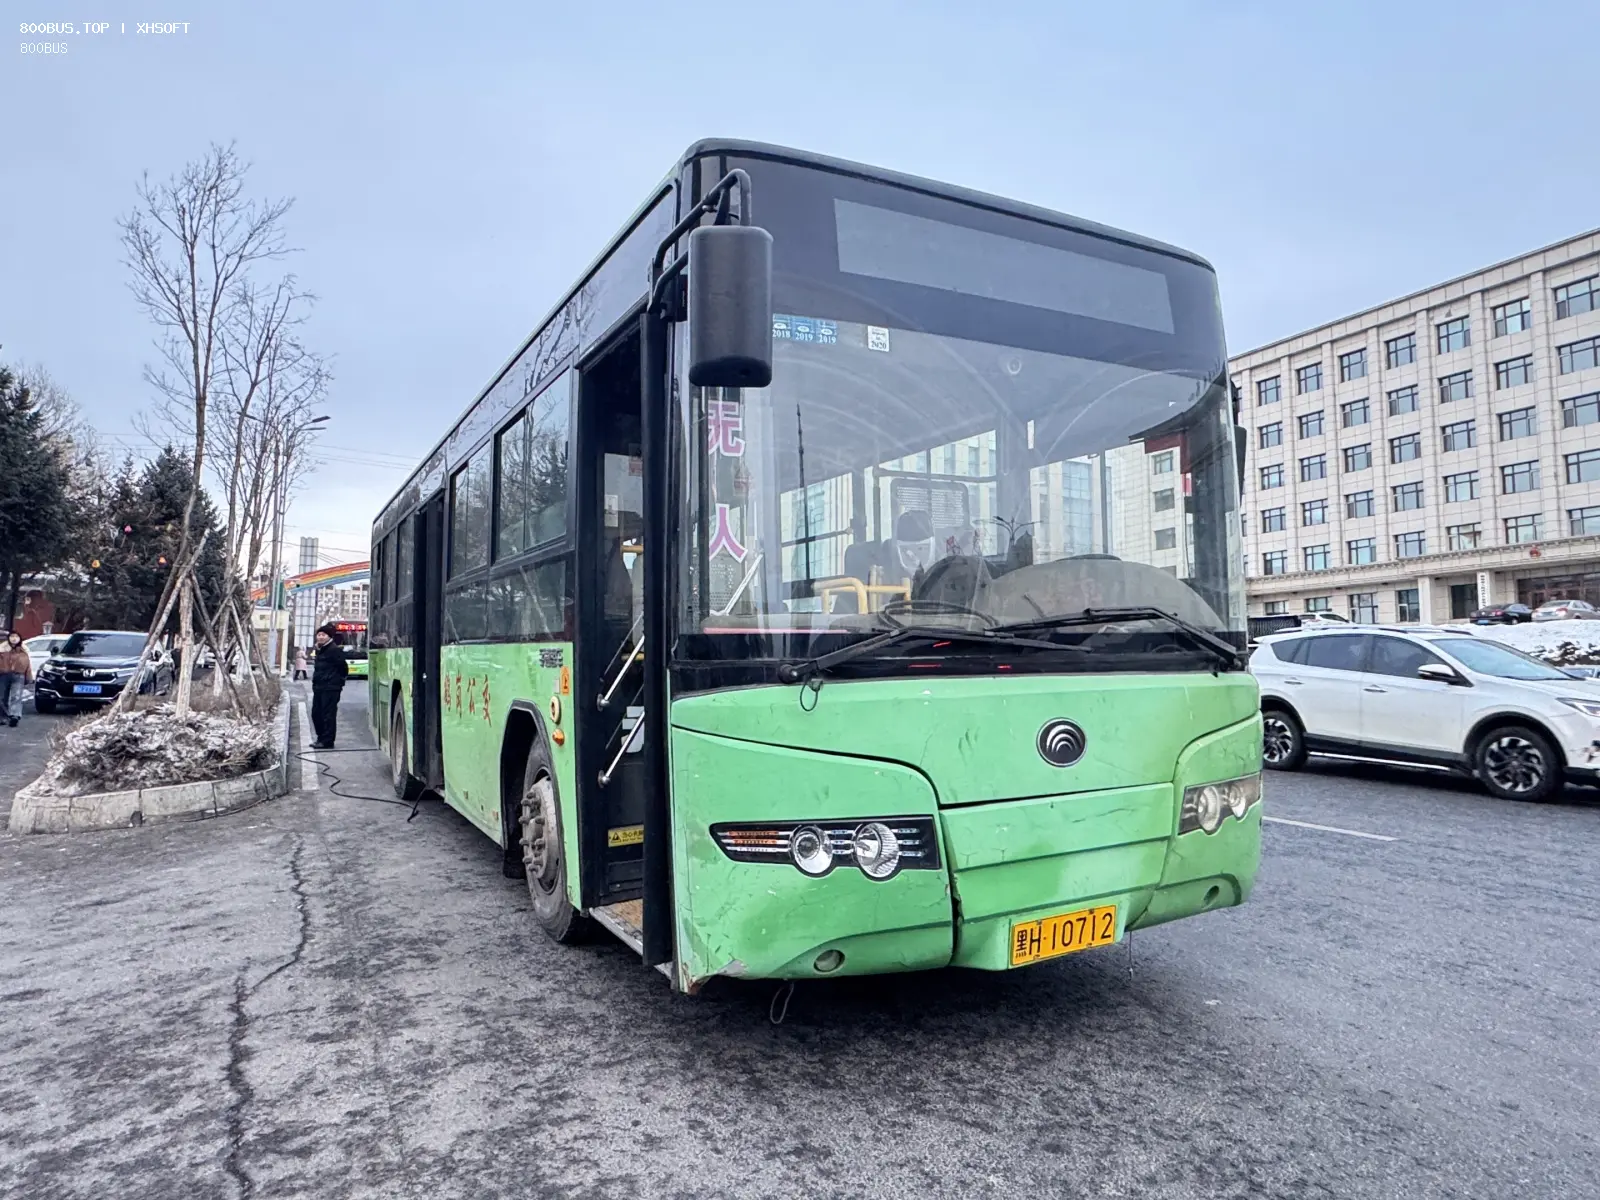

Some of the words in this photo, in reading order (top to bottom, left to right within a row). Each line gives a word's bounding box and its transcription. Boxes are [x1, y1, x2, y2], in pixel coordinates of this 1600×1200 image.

[772, 329, 791, 338] 2018
[795, 332, 814, 341] 2019
[818, 334, 837, 344] 2019
[871, 340, 887, 350] 2020
